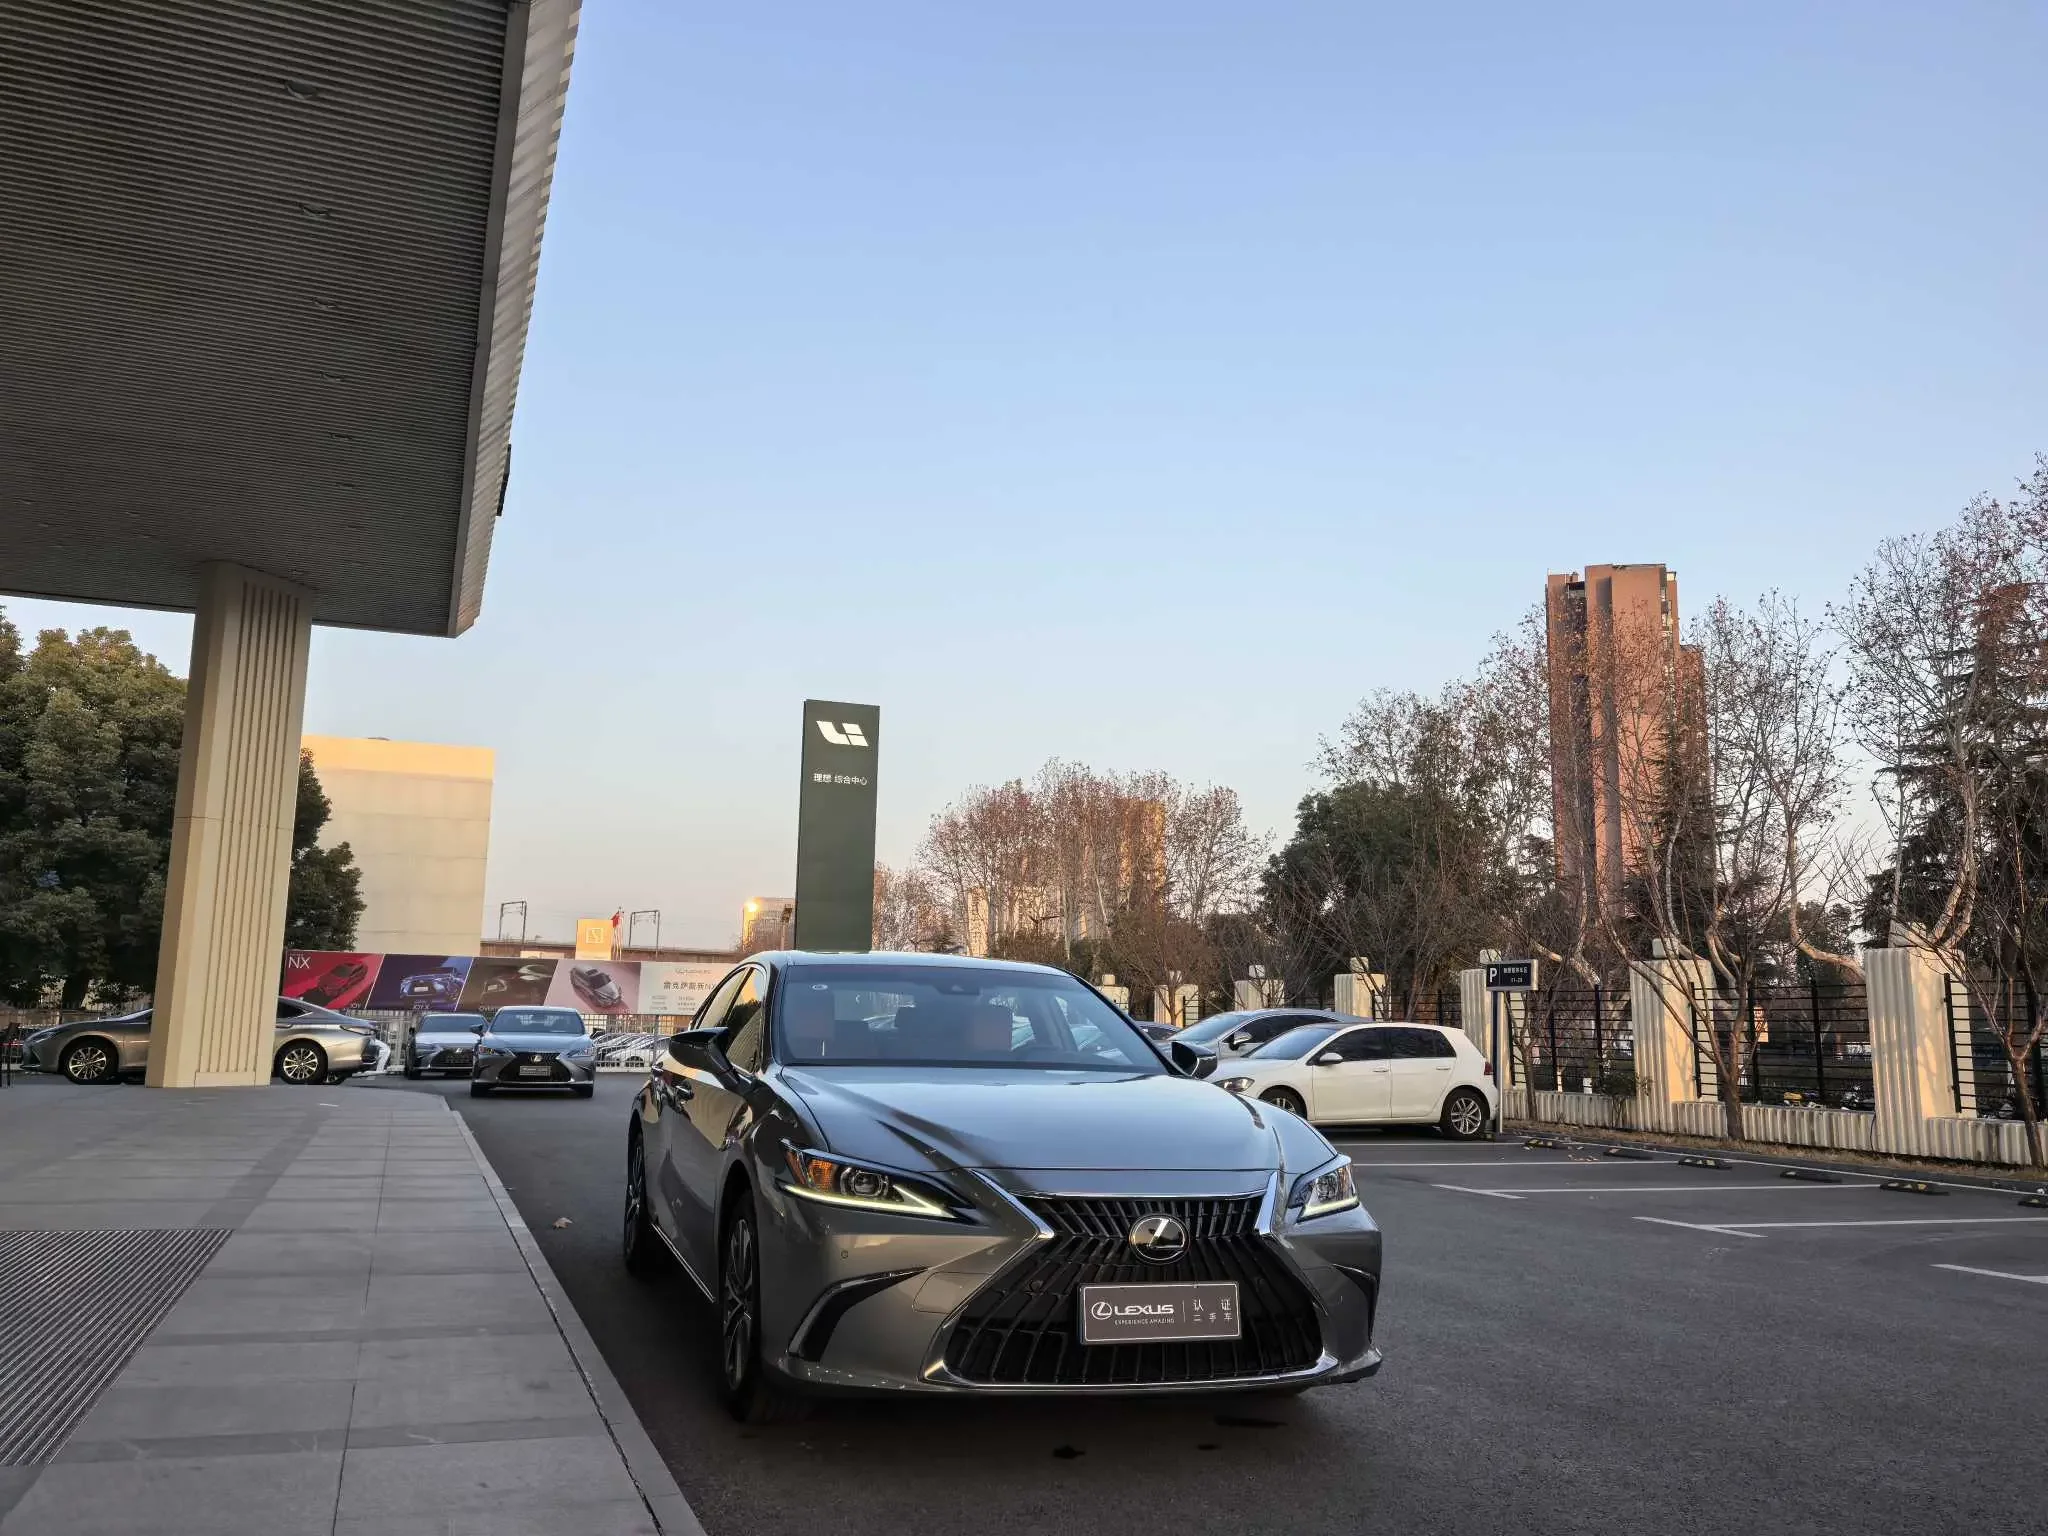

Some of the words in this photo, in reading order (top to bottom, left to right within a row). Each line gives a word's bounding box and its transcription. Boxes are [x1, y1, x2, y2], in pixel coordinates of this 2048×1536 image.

[814, 773, 832, 783] 理想
[834, 775, 868, 786] 综合中心
[288, 956, 310, 968] NX
[1490, 968, 1498, 982] P
[1114, 1304, 1175, 1316] LEXUS
[1114, 1318, 1149, 1326] EXPERIENCE
